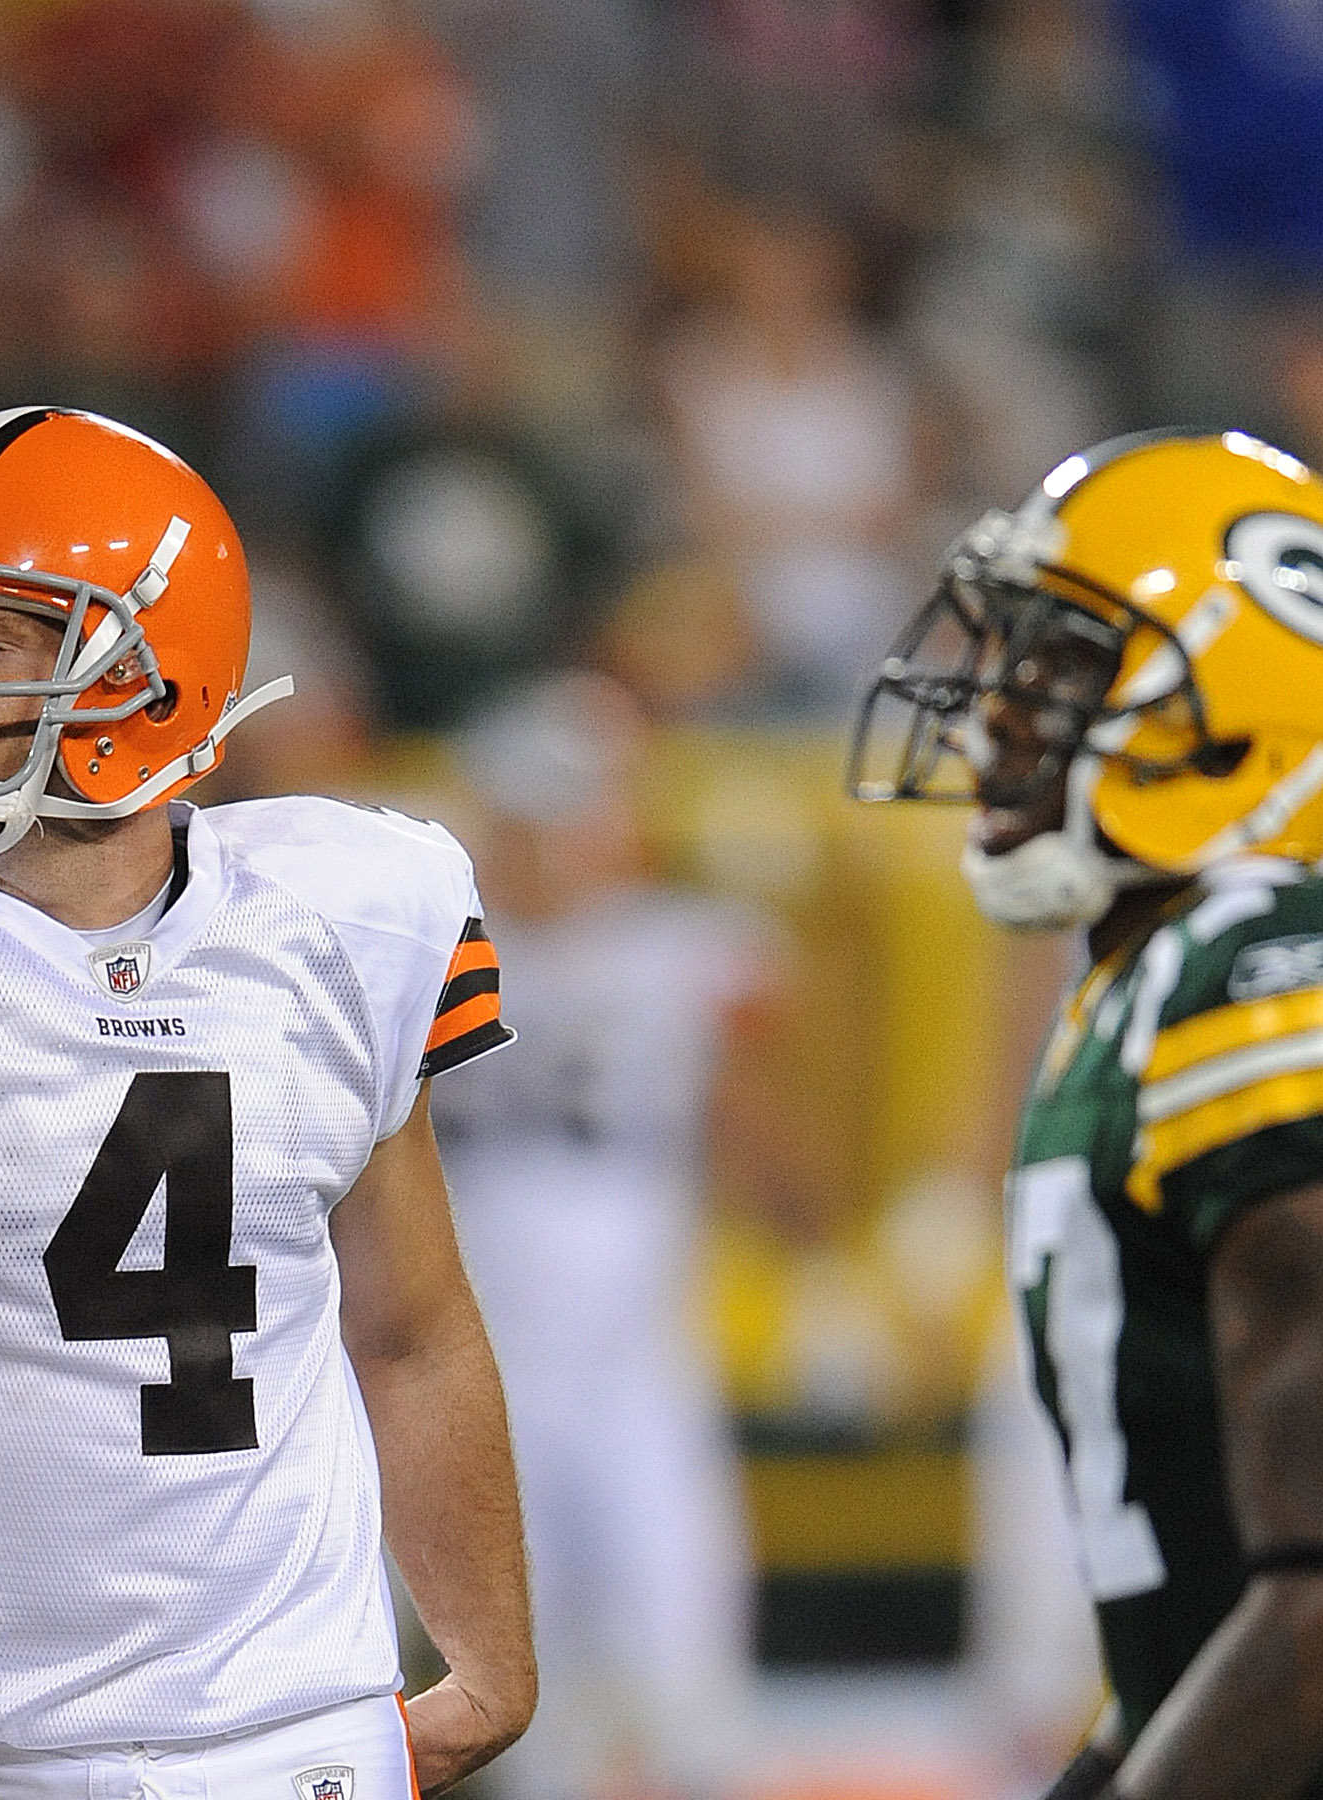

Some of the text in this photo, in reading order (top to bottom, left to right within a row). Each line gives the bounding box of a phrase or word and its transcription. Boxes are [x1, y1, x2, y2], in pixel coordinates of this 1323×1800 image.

[110, 971, 138, 990] NFL
[95, 1017, 186, 1037] BROWNS
[43, 1071, 259, 1455] 4
